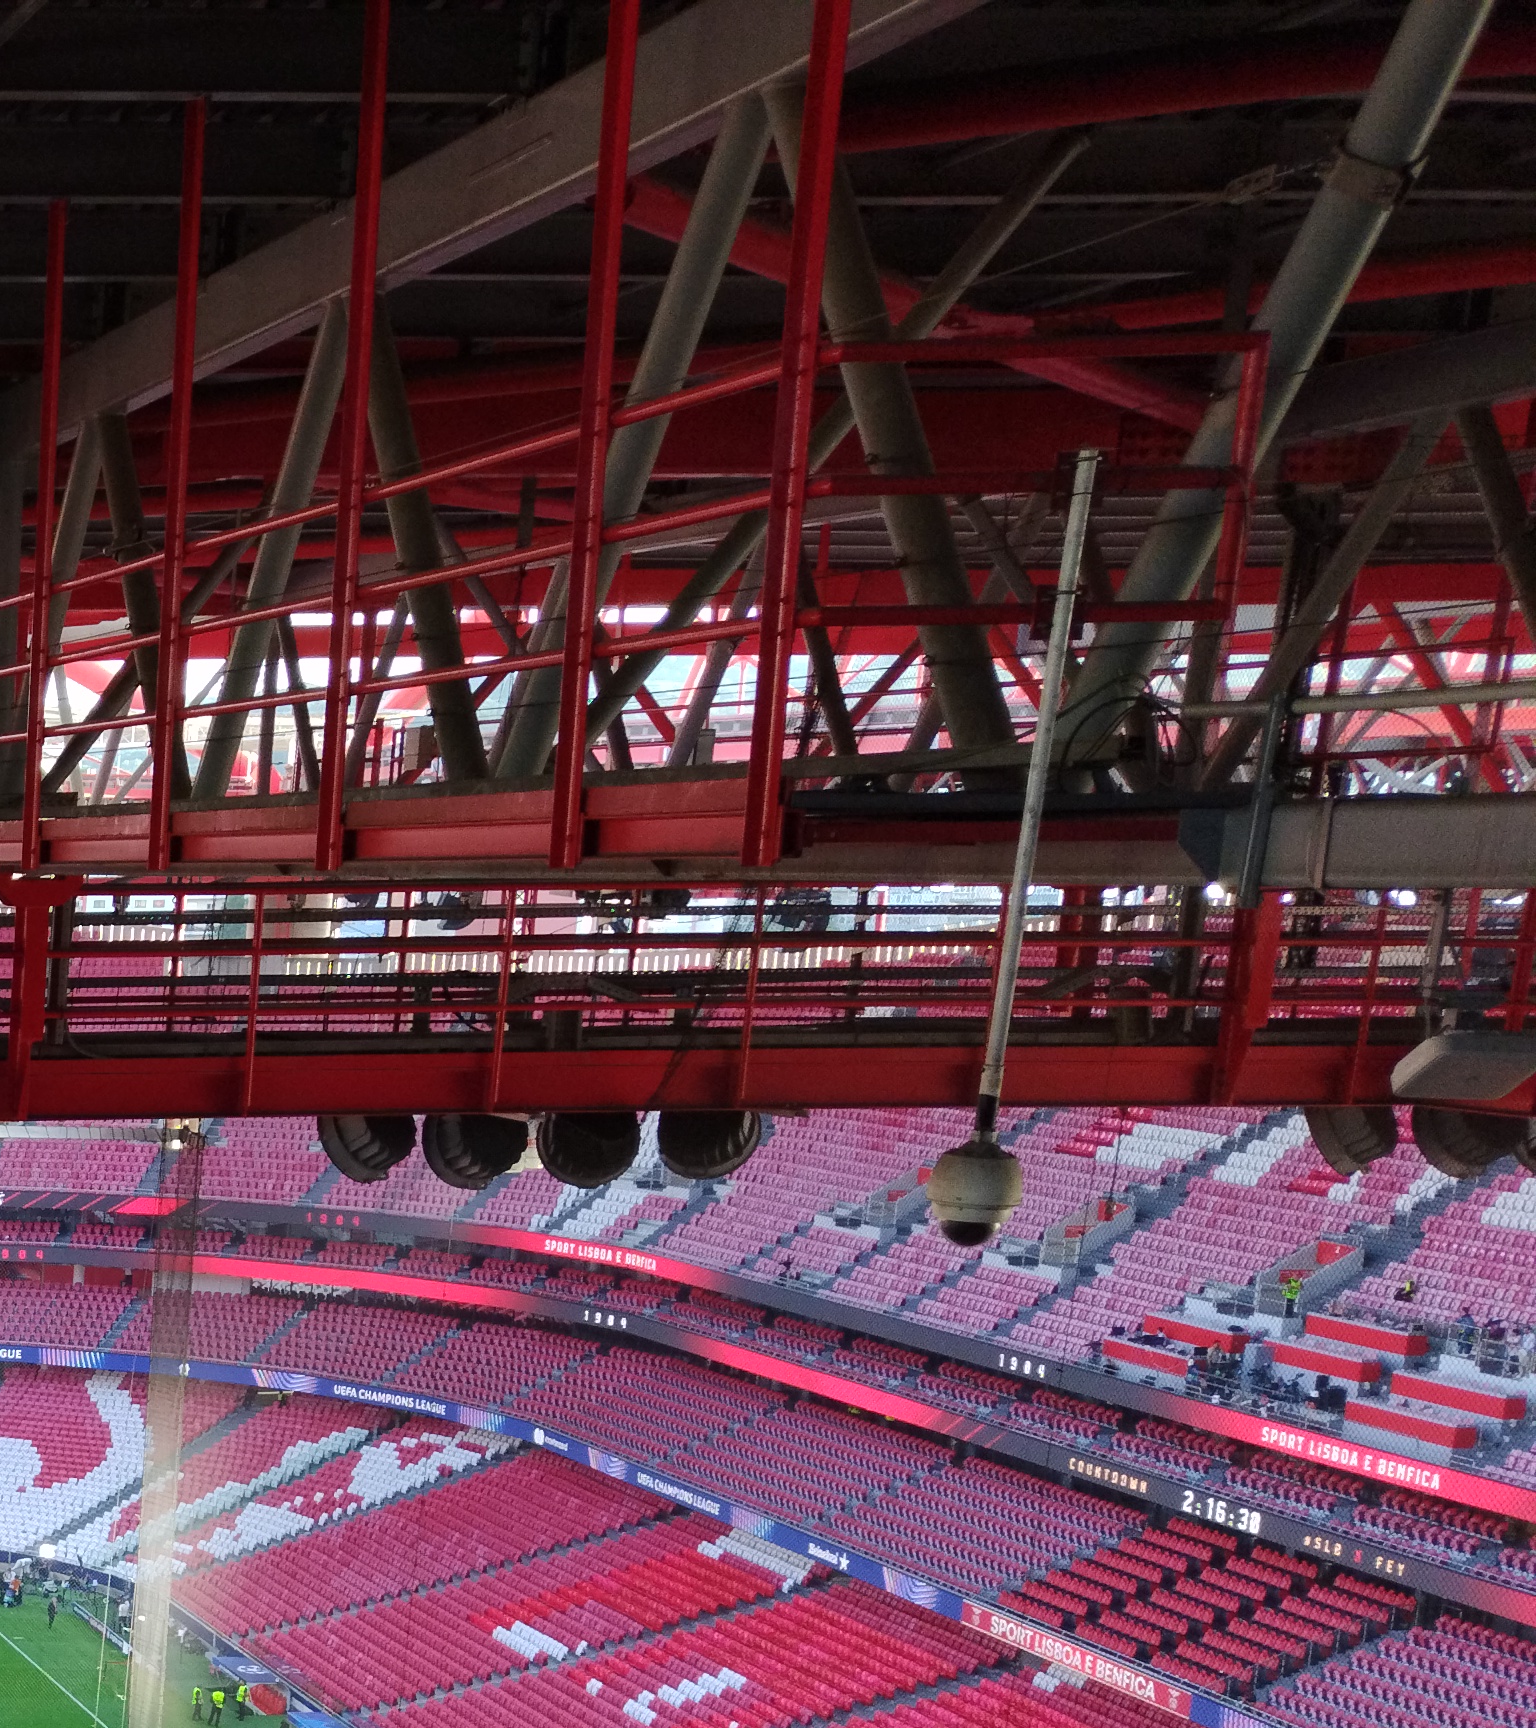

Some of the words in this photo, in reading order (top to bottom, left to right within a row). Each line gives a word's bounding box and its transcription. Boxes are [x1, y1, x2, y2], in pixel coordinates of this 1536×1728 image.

[544, 1239, 576, 1255] SPORT
[578, 1244, 613, 1261] LISBOA
[615, 1251, 622, 1263] E
[333, 1383, 358, 1400] UEFA
[358, 1388, 415, 1409] CHAMPIONS
[415, 1398, 447, 1416] LEAGUE
[1068, 1458, 1148, 1494] COUNTDOWN
[1260, 1426, 1305, 1453] SPORT
[1309, 1439, 1360, 1468] LISBOA
[1363, 1454, 1373, 1472] E
[1377, 1458, 1441, 1492] BENFICA
[636, 1471, 654, 1488] UEFA
[654, 1477, 693, 1505] CHAMPIONS
[692, 1493, 721, 1515] LEAGUE
[990, 1614, 1034, 1647] SPORT
[1034, 1632, 1083, 1670] LISBOA
[1085, 1656, 1094, 1671] E
[1094, 1659, 1156, 1701] BENFICA
